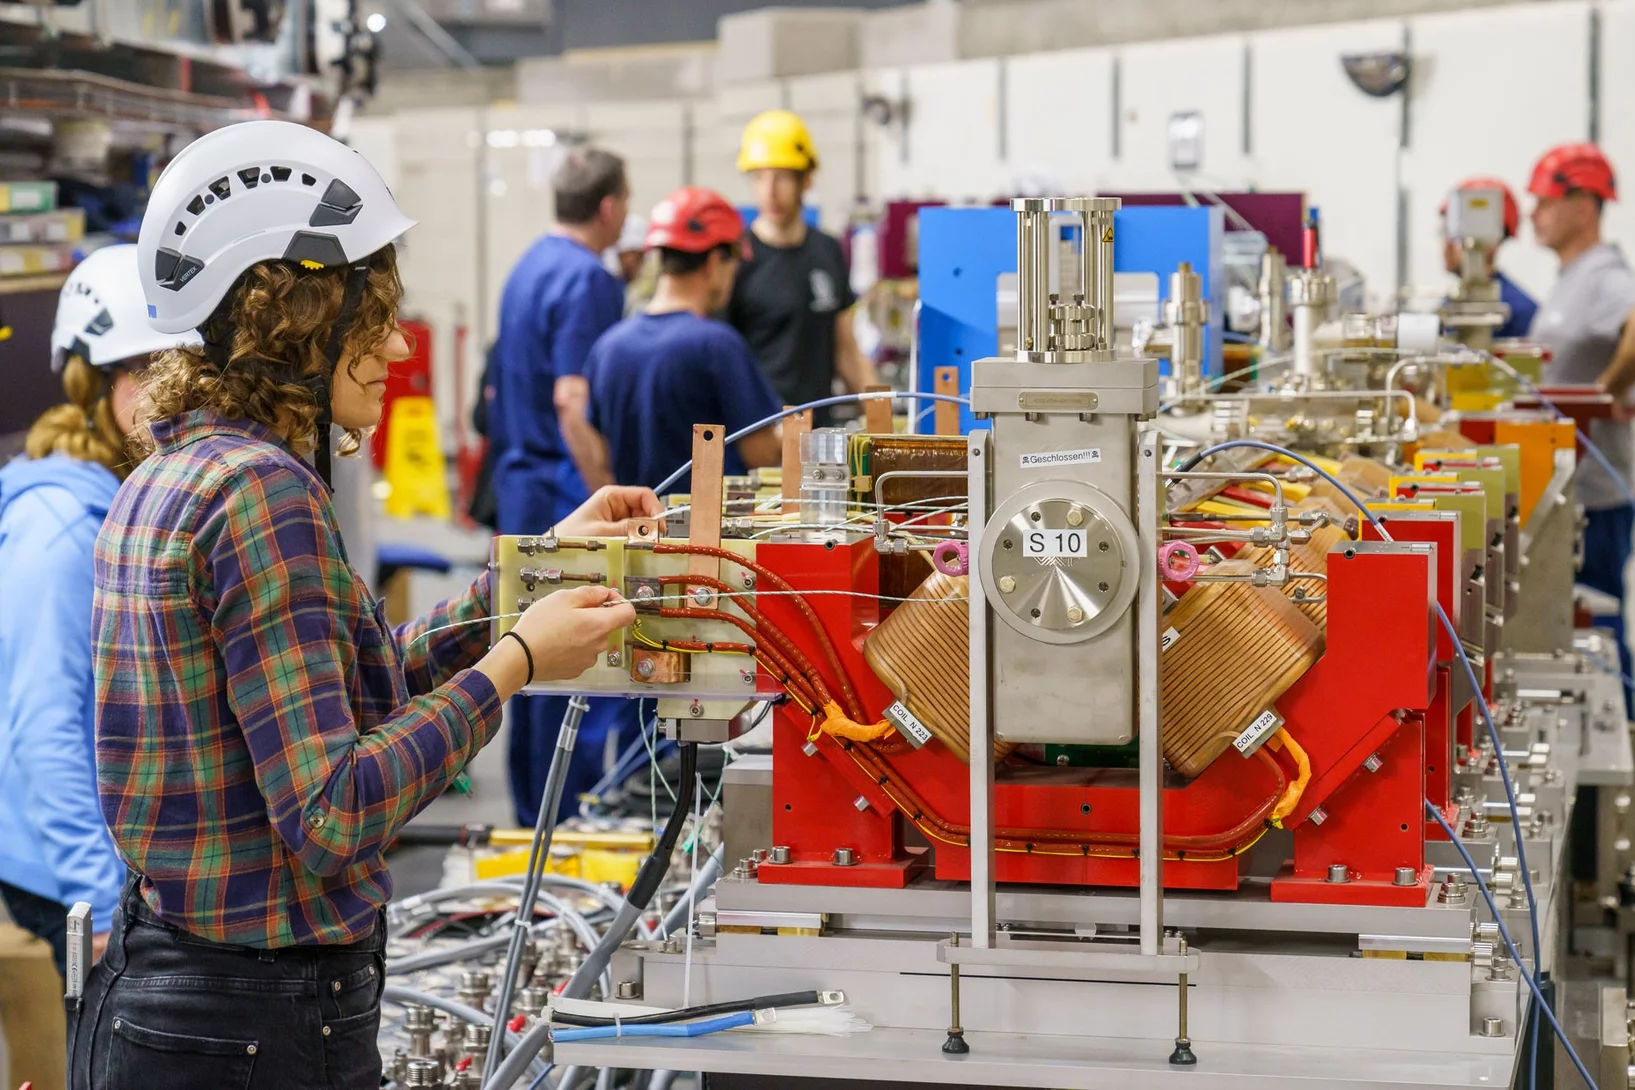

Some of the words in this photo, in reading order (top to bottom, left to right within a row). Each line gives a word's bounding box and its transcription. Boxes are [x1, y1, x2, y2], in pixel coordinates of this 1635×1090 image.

[180, 265, 198, 282] VERTEX
[1030, 452, 1091, 464] Geschlossen!!!
[1029, 532, 1045, 553] S
[1055, 532, 1081, 553] 10
[892, 704, 908, 722] COIL
[909, 721, 917, 730] N
[915, 727, 928, 741] 223
[1236, 733, 1254, 749] COIL
[1254, 724, 1262, 732] N
[1260, 713, 1273, 727] 229
